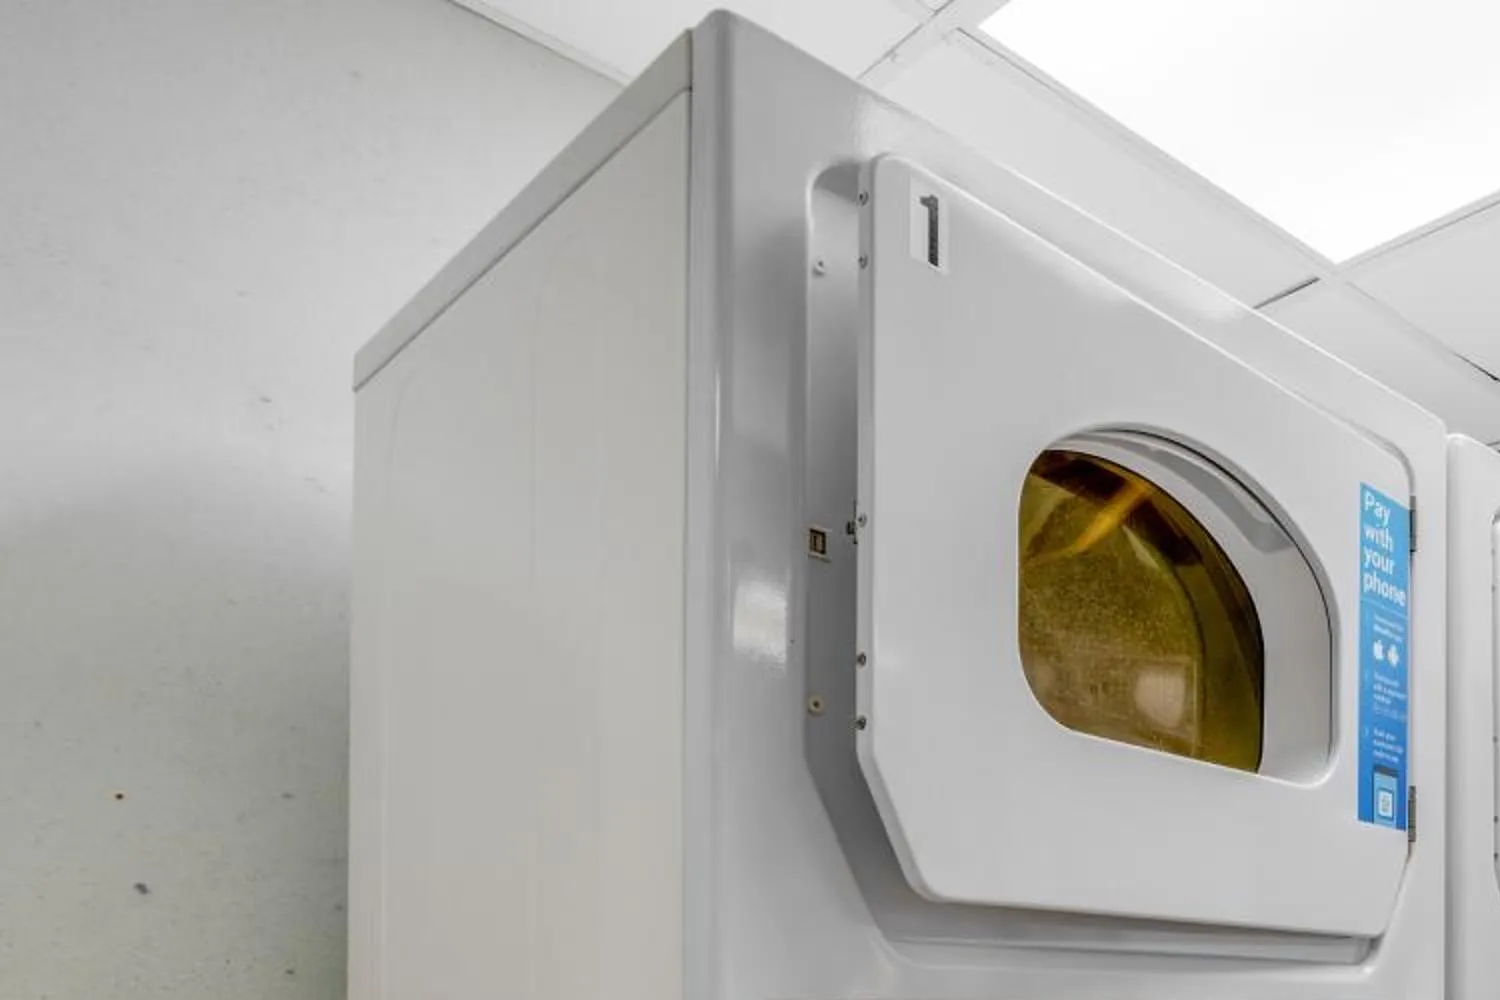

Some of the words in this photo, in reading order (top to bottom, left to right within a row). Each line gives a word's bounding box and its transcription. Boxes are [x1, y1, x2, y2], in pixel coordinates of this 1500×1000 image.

[919, 194, 939, 267] 1
[1364, 490, 1390, 528] Pay
[1364, 525, 1393, 553] with
[1363, 545, 1395, 575] your
[1363, 570, 1406, 607] phone
